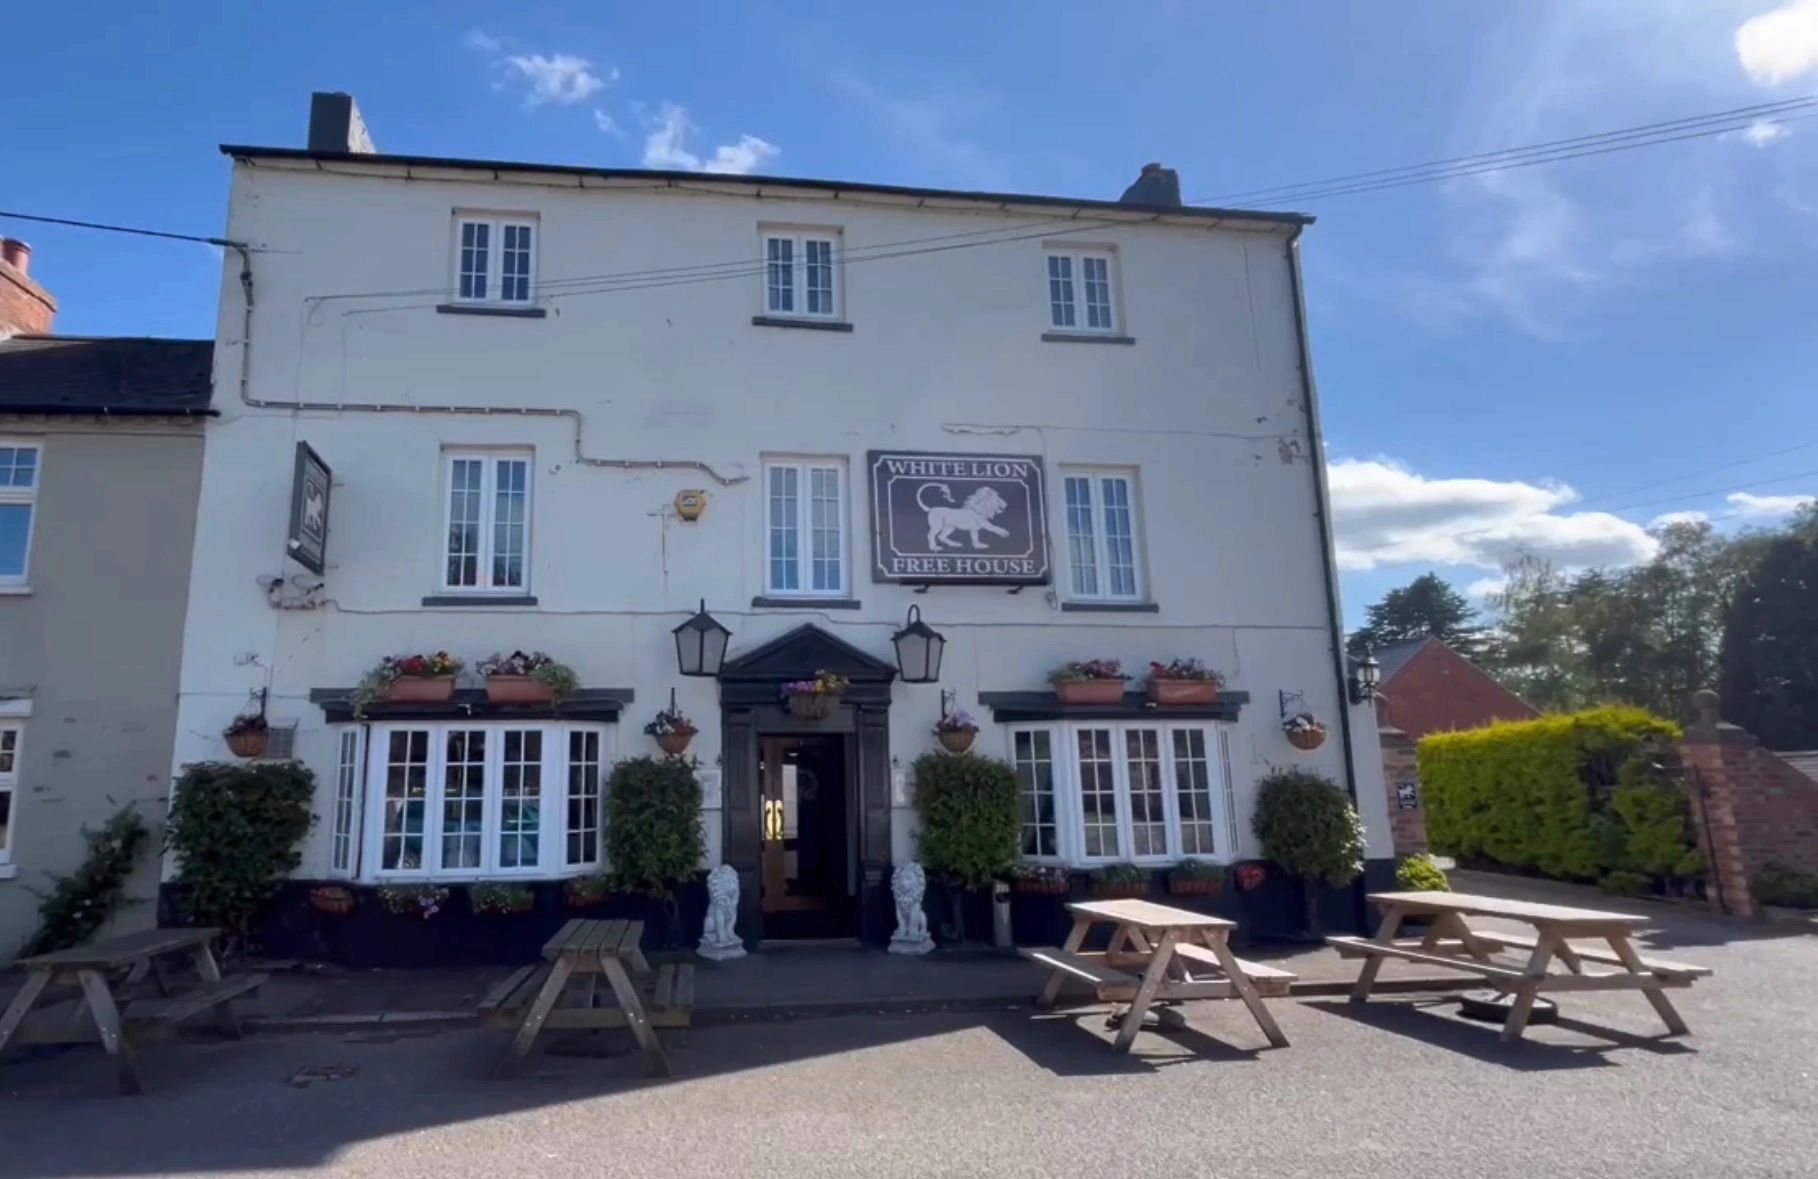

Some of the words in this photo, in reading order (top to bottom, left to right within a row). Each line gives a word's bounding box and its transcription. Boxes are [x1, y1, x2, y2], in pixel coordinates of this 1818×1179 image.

[887, 459, 965, 477] WHITE
[971, 462, 1028, 478] LION
[892, 558, 950, 573] FREE
[956, 558, 1035, 574] HOUSE
